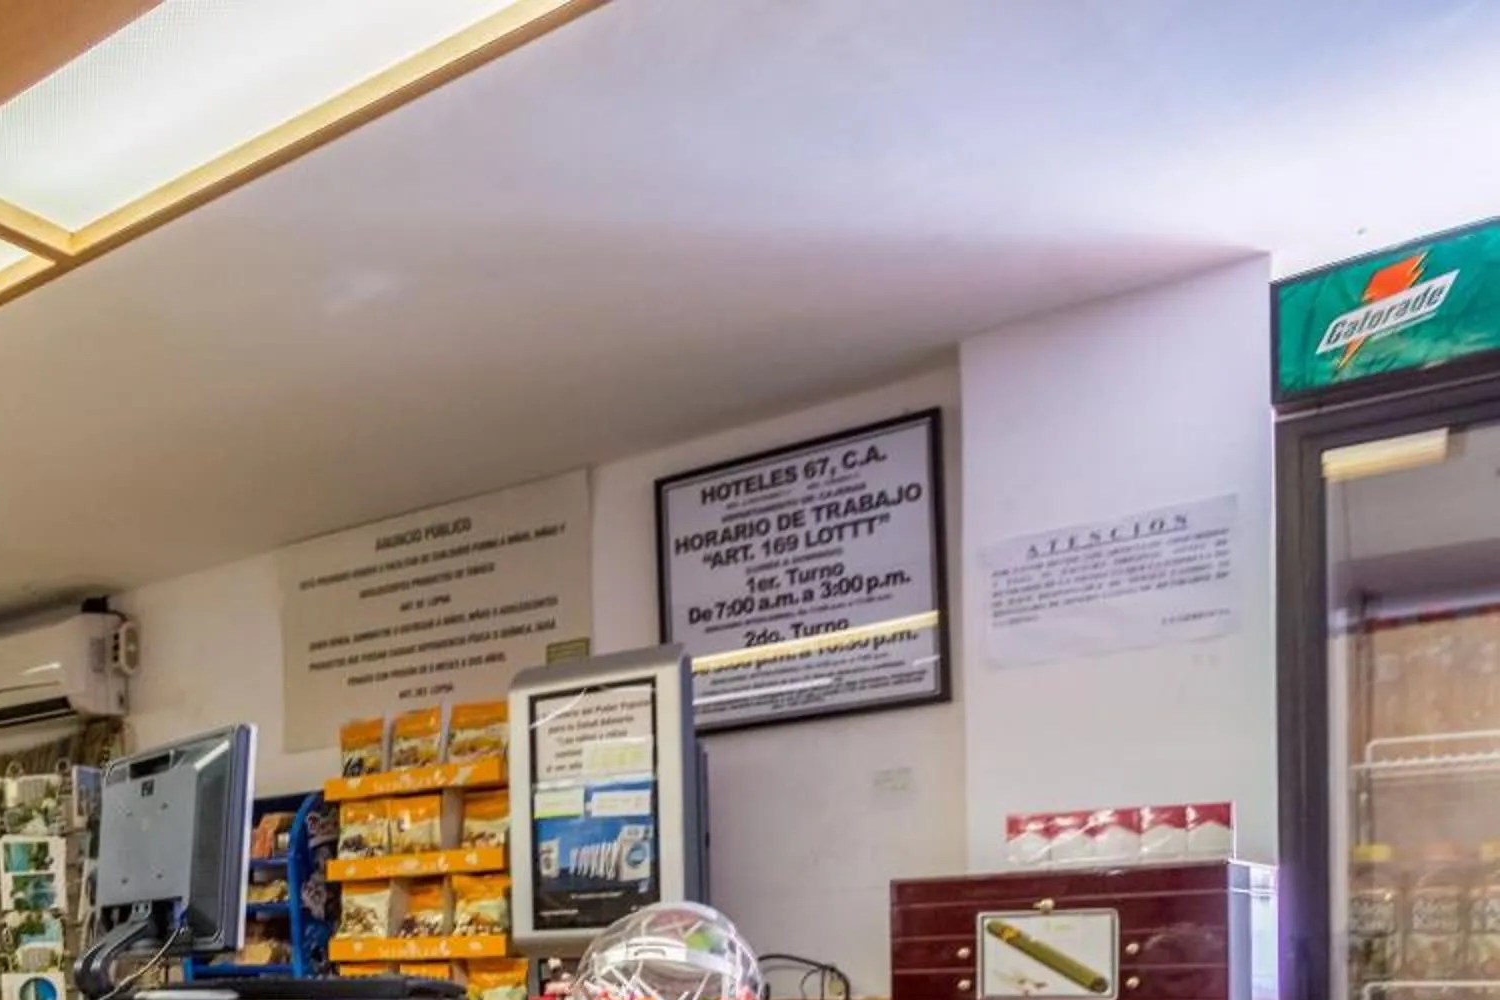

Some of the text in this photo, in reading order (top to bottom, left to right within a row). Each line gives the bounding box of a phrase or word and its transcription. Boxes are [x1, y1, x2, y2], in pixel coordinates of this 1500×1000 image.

[1326, 284, 1446, 345] Gatorade
[700, 464, 798, 506] HOTELES
[802, 454, 836, 483] 67,
[841, 440, 887, 471] C.A.
[376, 527, 421, 553] ANUNCIO
[674, 516, 771, 555] HORARIO
[776, 508, 805, 532] DE
[813, 480, 922, 523] TRABAJO
[761, 533, 799, 558] 169
[688, 605, 711, 624] De
[715, 597, 753, 619] 7:00
[758, 588, 798, 611] a.m.
[801, 589, 813, 602] a
[819, 575, 862, 599] 3:00
[865, 568, 911, 594] p.m.
[745, 558, 844, 594] 1er. Turno
[743, 612, 849, 647] 2do. Turno
